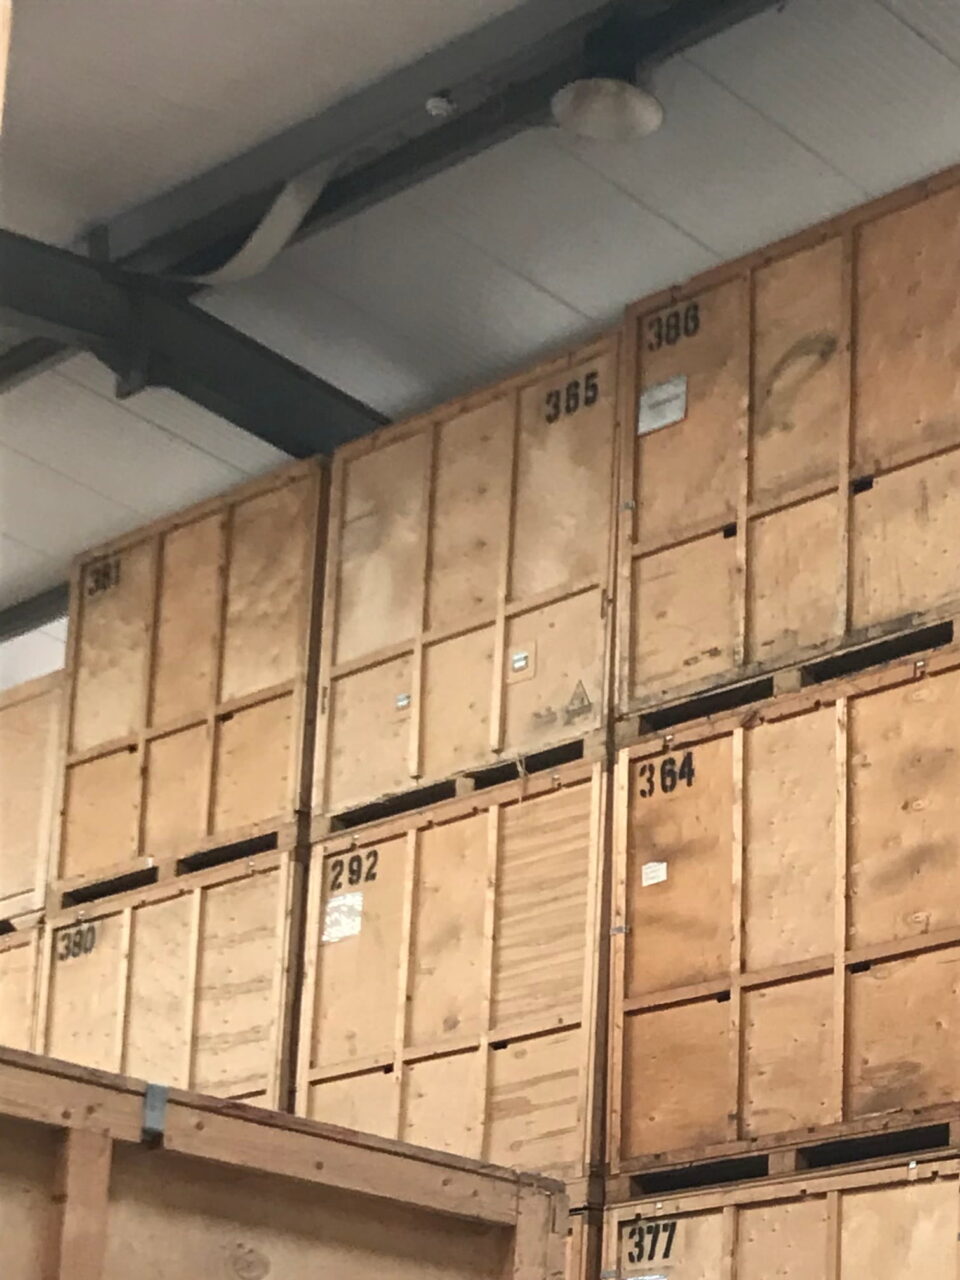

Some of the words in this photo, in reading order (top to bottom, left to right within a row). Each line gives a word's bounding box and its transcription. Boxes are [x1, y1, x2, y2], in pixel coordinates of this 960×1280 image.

[639, 751, 695, 798] 364
[330, 850, 379, 891] 292
[628, 1222, 677, 1263] 377
